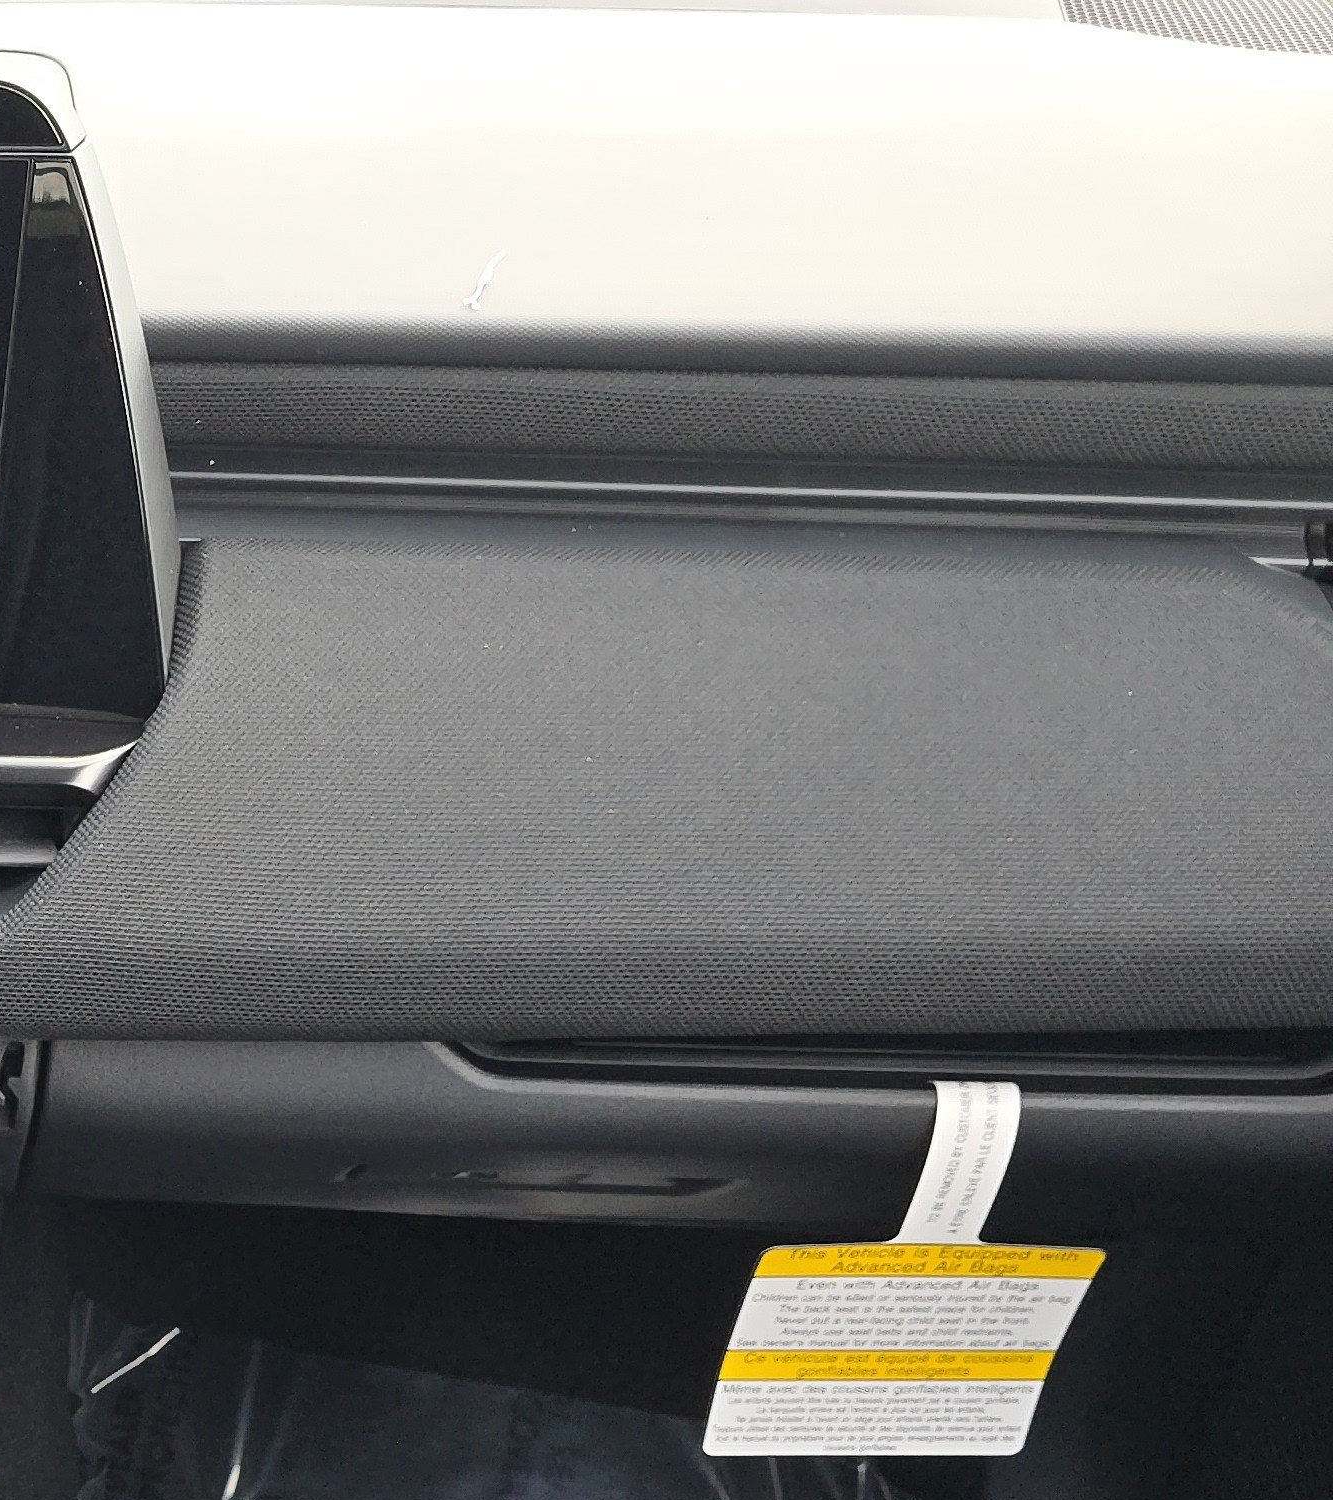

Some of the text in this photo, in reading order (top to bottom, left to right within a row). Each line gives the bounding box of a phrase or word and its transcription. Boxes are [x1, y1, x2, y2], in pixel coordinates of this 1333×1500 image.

[789, 1247, 1080, 1261] This Vehicle is Equipped with
[831, 1261, 1020, 1276] Advanced Air Bags
[881, 1280, 963, 1291] Advanced
[966, 1280, 992, 1291] Air
